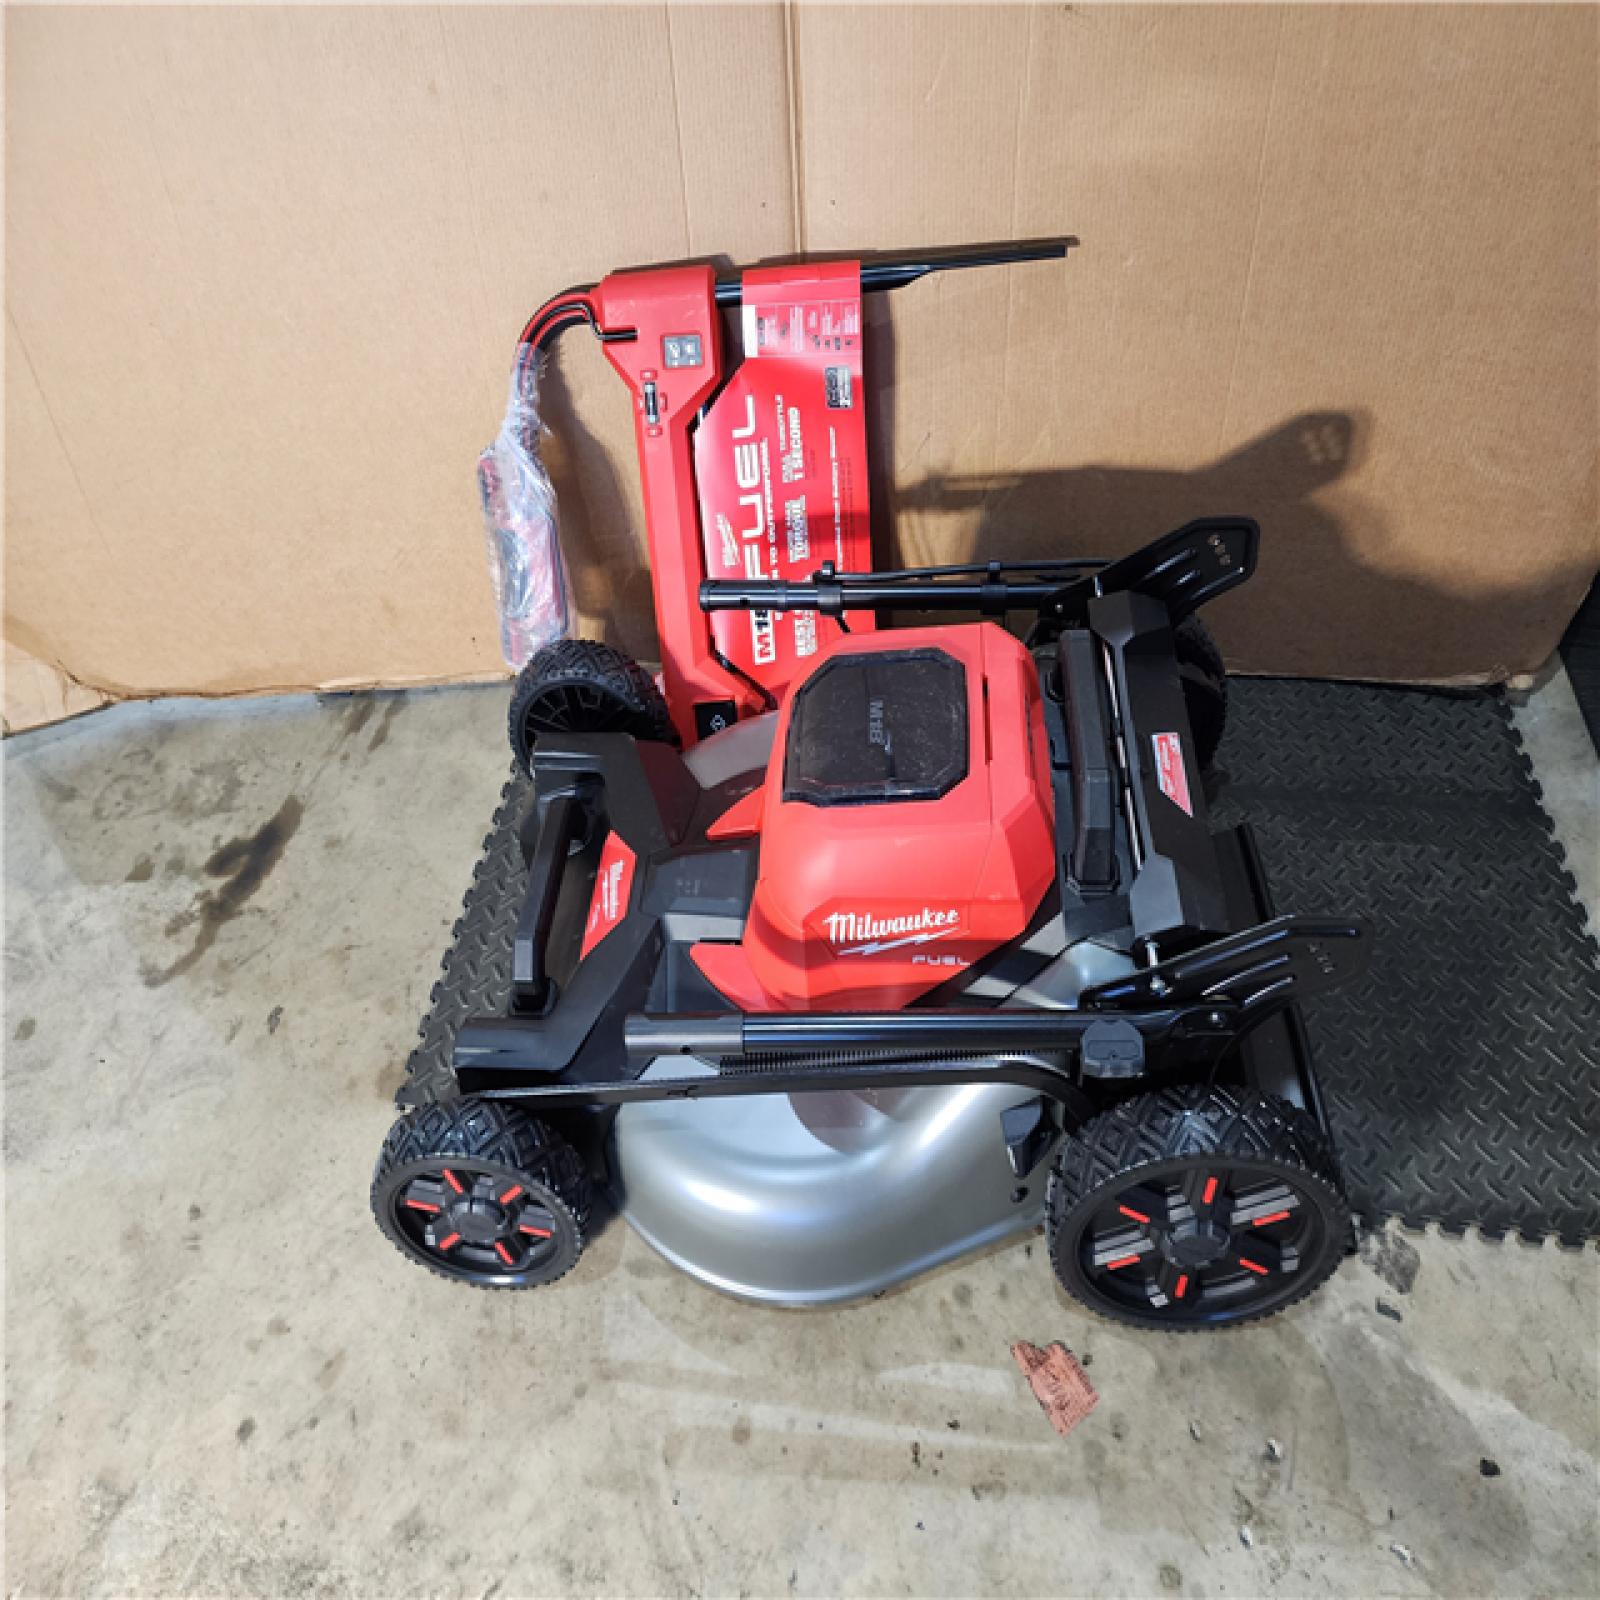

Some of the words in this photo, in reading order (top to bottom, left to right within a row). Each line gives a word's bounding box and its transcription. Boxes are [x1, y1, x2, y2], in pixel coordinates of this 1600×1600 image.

[788, 407, 804, 469] SECOND
[732, 394, 769, 579] FUEL
[822, 907, 961, 945] Milwaukee
[911, 954, 971, 966] FUEL
